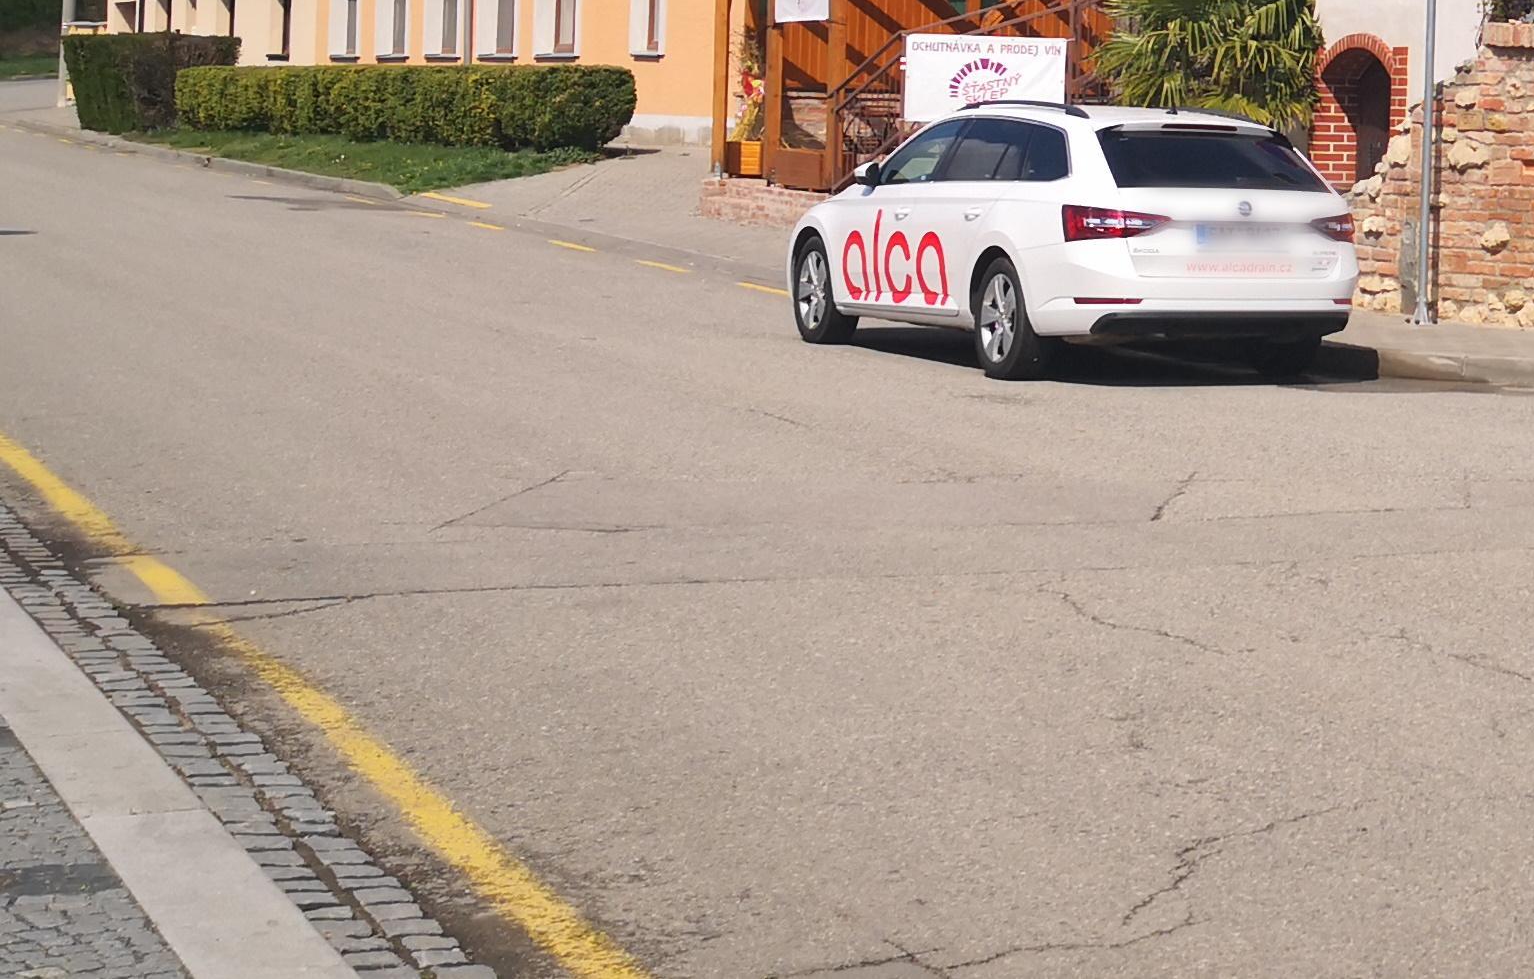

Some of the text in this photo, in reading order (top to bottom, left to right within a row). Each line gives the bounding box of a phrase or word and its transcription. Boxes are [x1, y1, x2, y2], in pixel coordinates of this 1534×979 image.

[911, 41, 981, 54] OCHUTNÁVKA
[987, 44, 995, 54] A
[1001, 45, 1039, 57] PRODEJ
[842, 208, 948, 306] alca
[1186, 258, 1293, 272] www.alcadrain.cz
